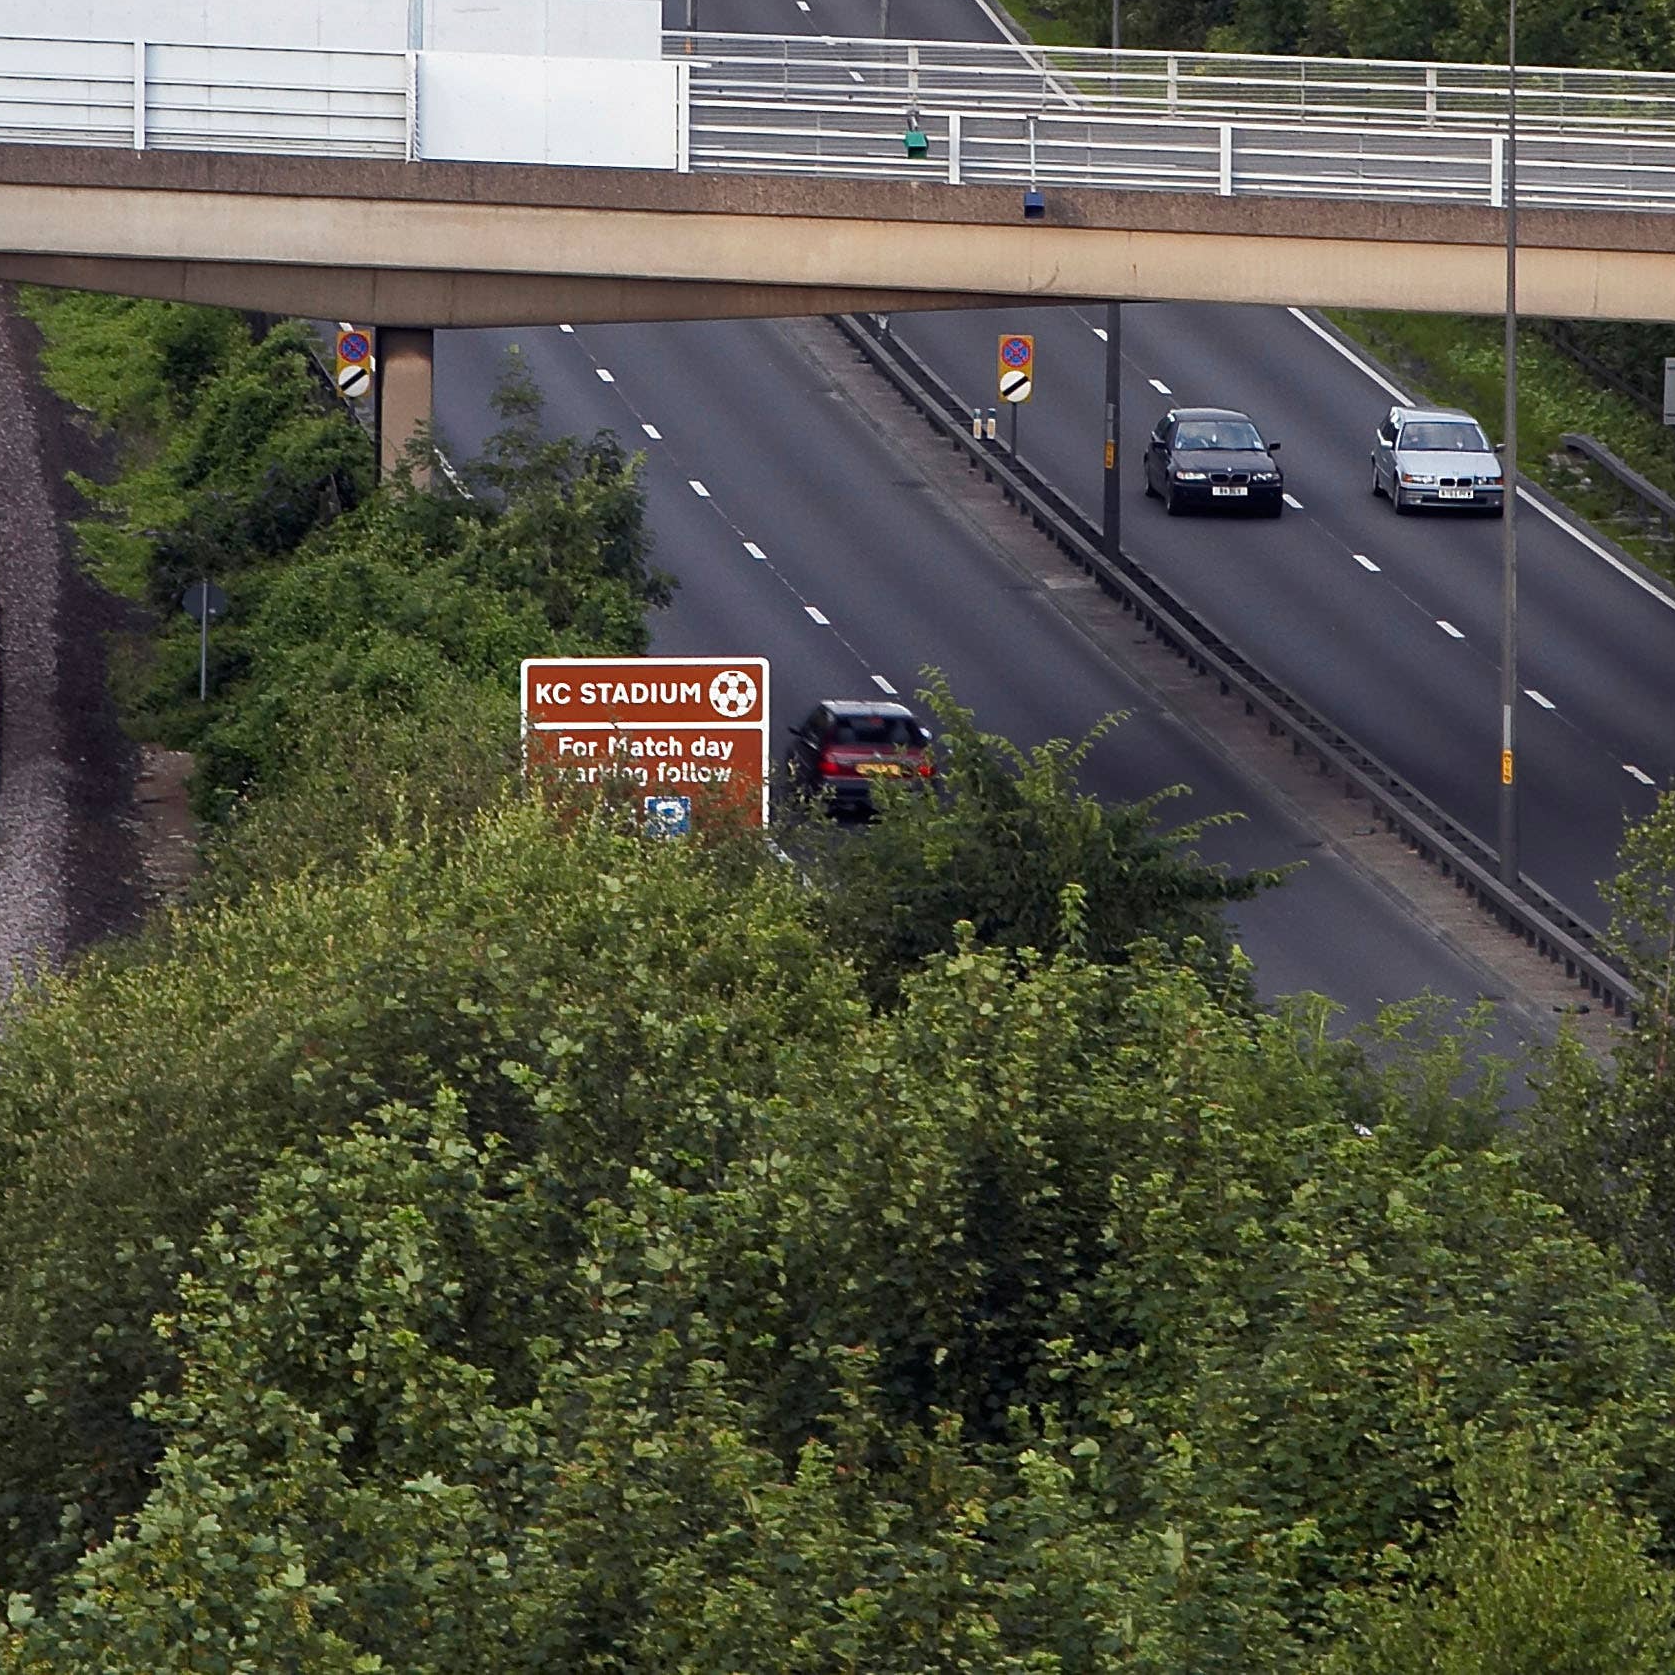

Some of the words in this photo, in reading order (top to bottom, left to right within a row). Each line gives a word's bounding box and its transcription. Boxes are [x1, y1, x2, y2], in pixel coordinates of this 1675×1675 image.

[535, 682, 571, 704] KC
[580, 682, 701, 704] STADIUM
[558, 737, 598, 757] For
[608, 736, 683, 757] Match
[690, 736, 734, 760] day
[656, 761, 732, 783] follow
